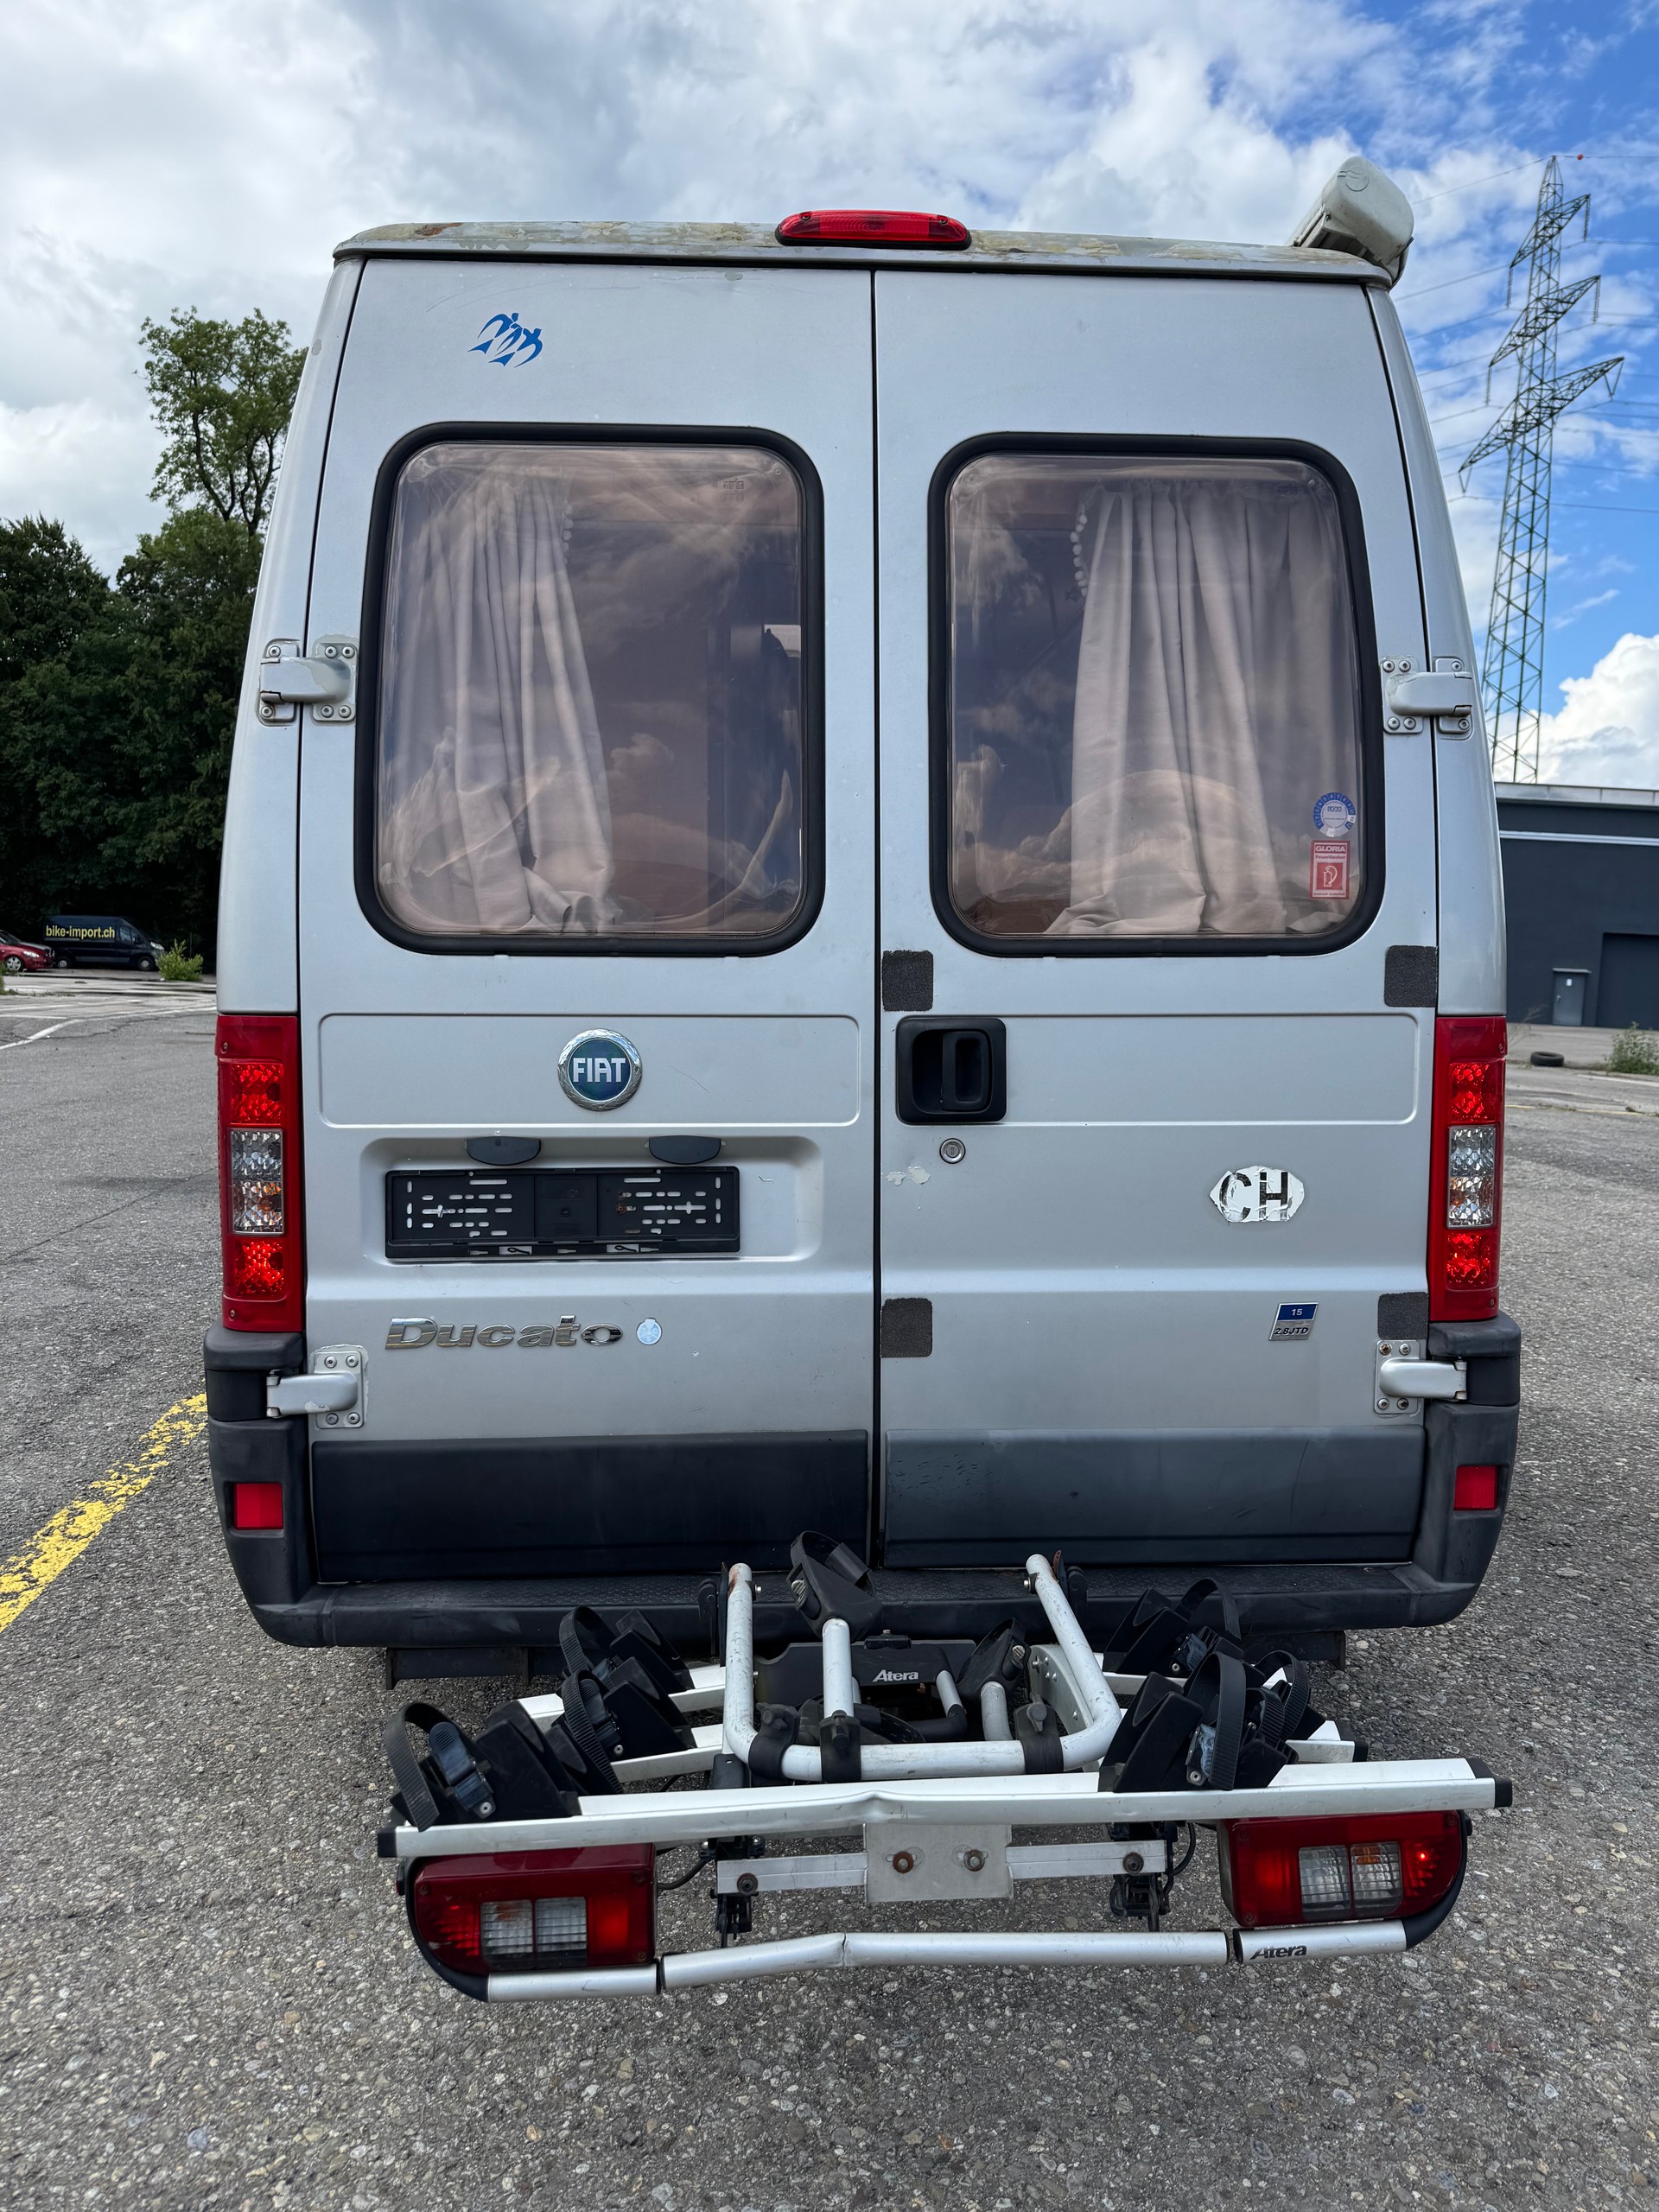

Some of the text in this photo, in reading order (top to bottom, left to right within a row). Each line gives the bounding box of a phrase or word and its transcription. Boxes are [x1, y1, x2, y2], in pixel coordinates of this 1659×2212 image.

[46, 925, 115, 940] bike-import.ch
[573, 1058, 626, 1083] FIAT
[1219, 1172, 1288, 1220] CH
[385, 1314, 623, 1350] Ducato
[872, 1669, 919, 1682] Atera
[1249, 1945, 1307, 1960] Atera
